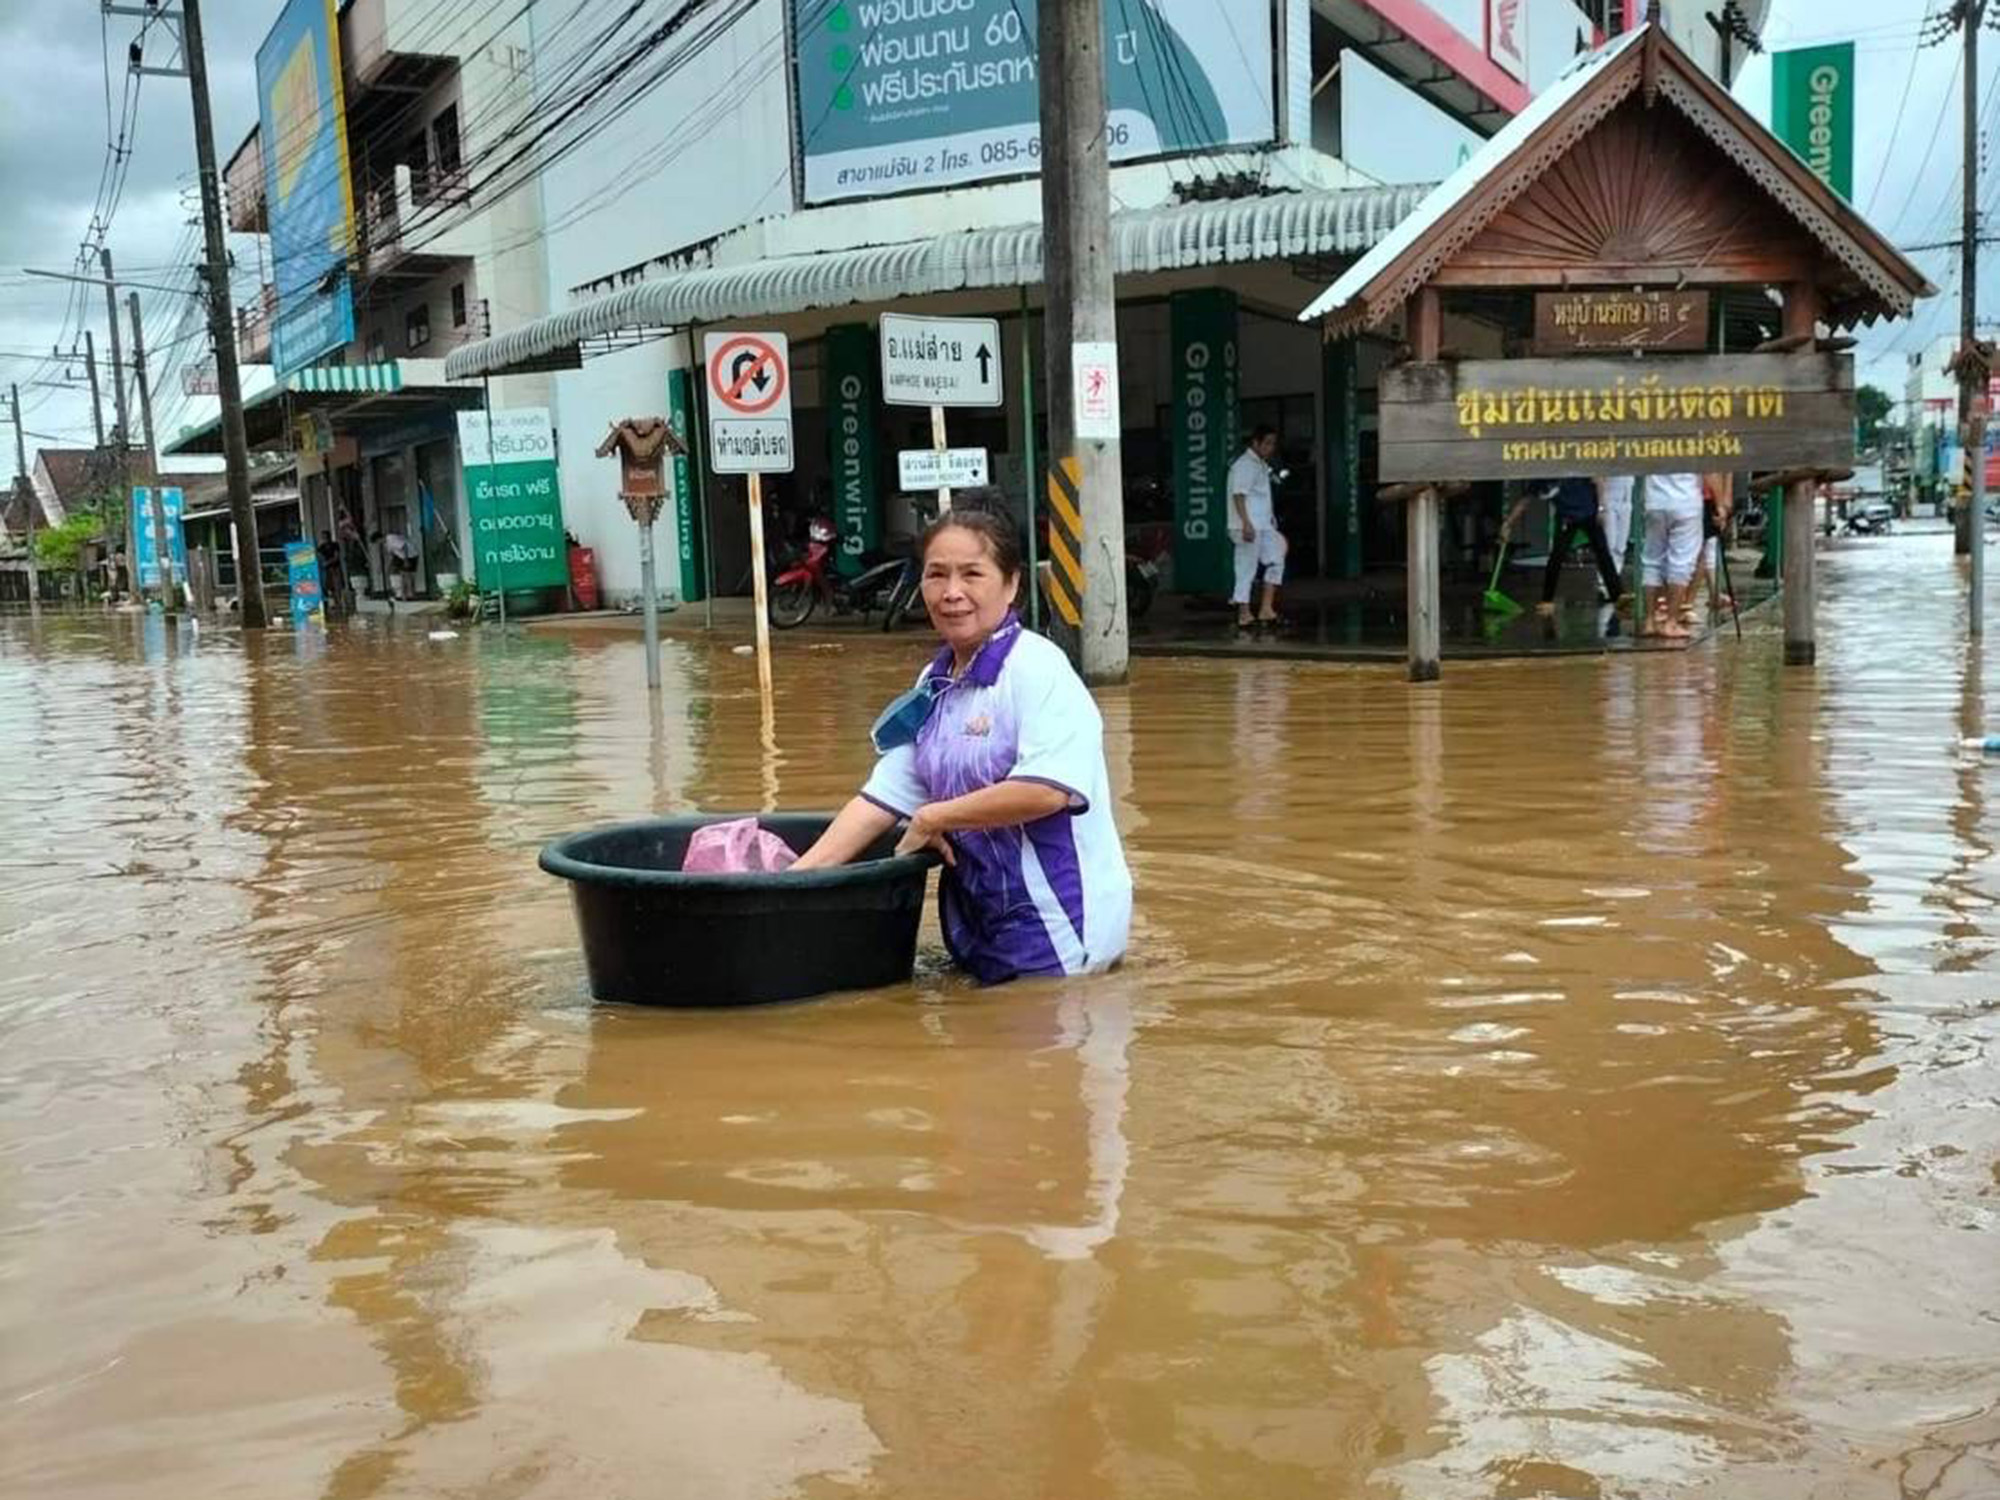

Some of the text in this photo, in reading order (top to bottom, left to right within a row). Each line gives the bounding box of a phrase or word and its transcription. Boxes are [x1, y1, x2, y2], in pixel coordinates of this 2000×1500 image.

[860, 10, 1021, 68] ผ่อนนาน 60
[862, 54, 1038, 107] ฟรีประกันรถห
[837, 156, 918, 185] สาขาแม่จัน
[923, 155, 935, 174] 2
[888, 330, 962, 362] อ.แม่สาย
[1223, 341, 1237, 466] Green
[1457, 375, 1784, 439] ชุมชนแม่จันตลาด
[717, 427, 787, 456] ห้ามกลับรถ
[840, 374, 867, 556] Greenwing
[1184, 342, 1214, 540] Greenwing
[1502, 429, 1742, 461] เทศบาลตำบลแม่จัน
[525, 478, 551, 496] ฟรี
[673, 410, 690, 560] Grenwing
